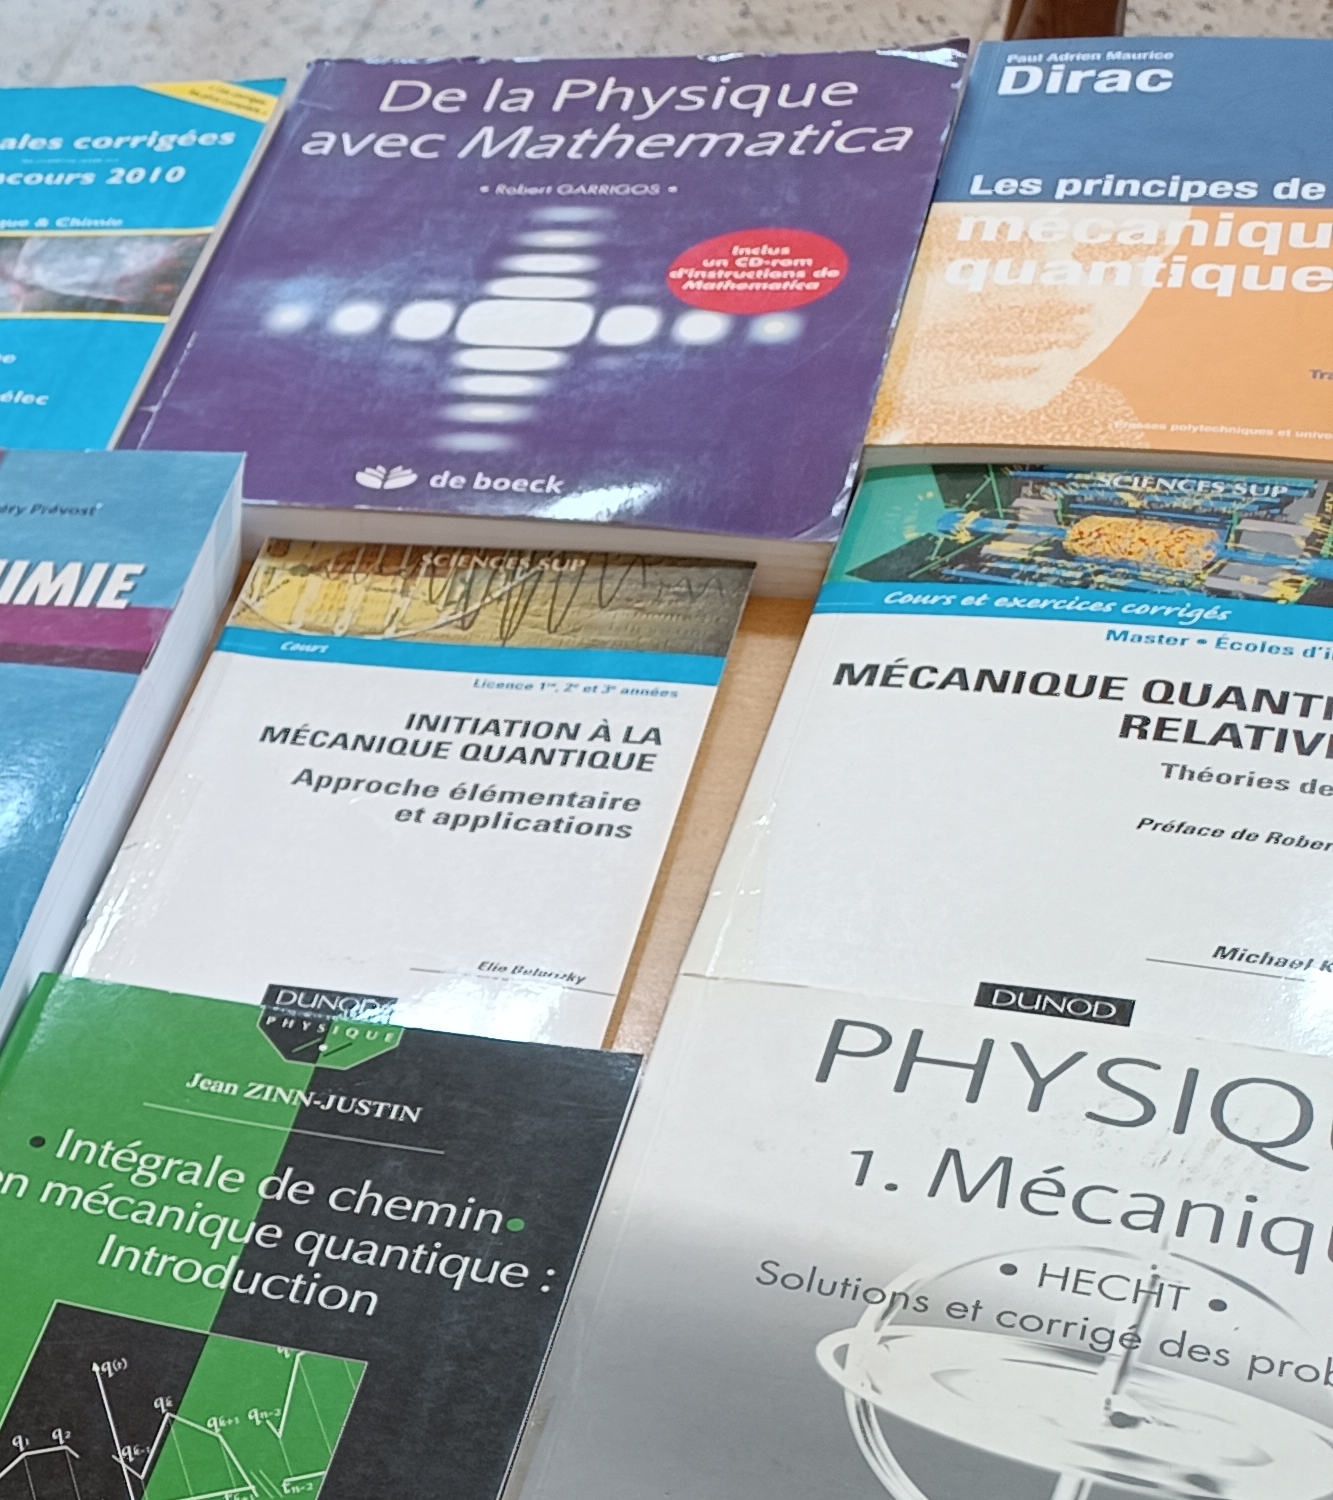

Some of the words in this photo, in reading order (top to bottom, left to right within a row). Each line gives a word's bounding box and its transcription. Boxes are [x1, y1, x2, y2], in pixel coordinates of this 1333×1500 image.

[1006, 52, 1041, 65] Paul
[1045, 51, 1101, 64] Adrien
[1105, 49, 1175, 62] Maurice
[376, 78, 469, 115] De
[483, 78, 538, 114] la
[551, 76, 860, 119] Physique
[996, 64, 1175, 96] Dirac
[69, 127, 236, 153] corrigées
[300, 127, 448, 160] avec
[456, 122, 915, 162] Mathematica
[105, 164, 186, 185] 2010
[969, 174, 1044, 198] Les
[1054, 175, 1263, 202] principes
[1272, 176, 1327, 200] de
[419, 552, 532, 574] SCIENCES
[538, 555, 586, 574] SUP
[884, 589, 956, 607] Cours
[960, 593, 991, 607] et
[993, 594, 1117, 615] exercices
[1121, 598, 1234, 626] corrigés
[831, 656, 1130, 702] MÉCANIQUE
[258, 721, 452, 762] MÉCANIQUE
[458, 741, 657, 774] QUANTIQUE
[403, 710, 581, 743] INITIATION
[585, 711, 613, 744] À
[620, 721, 664, 746] LA
[290, 766, 441, 801] Approche
[448, 778, 643, 813] élémentaire
[393, 805, 426, 824] et
[431, 805, 634, 840] applications
[184, 1070, 239, 1100] Jean
[244, 1079, 424, 1125] ZINN-JUSTIN
[54, 1127, 248, 1195] Intégrale
[257, 1163, 318, 1205] de
[327, 1178, 503, 1237] chemin
[38, 1171, 284, 1251] mécanique
[293, 1229, 532, 1293] quantique
[97, 1232, 380, 1318] Introduction
[1038, 1262, 1191, 1312] HECHT
[755, 1258, 932, 1315] Solutions
[945, 1300, 983, 1322] et
[995, 1315, 1143, 1355] corrigé
[1159, 1330, 1231, 1368] des
